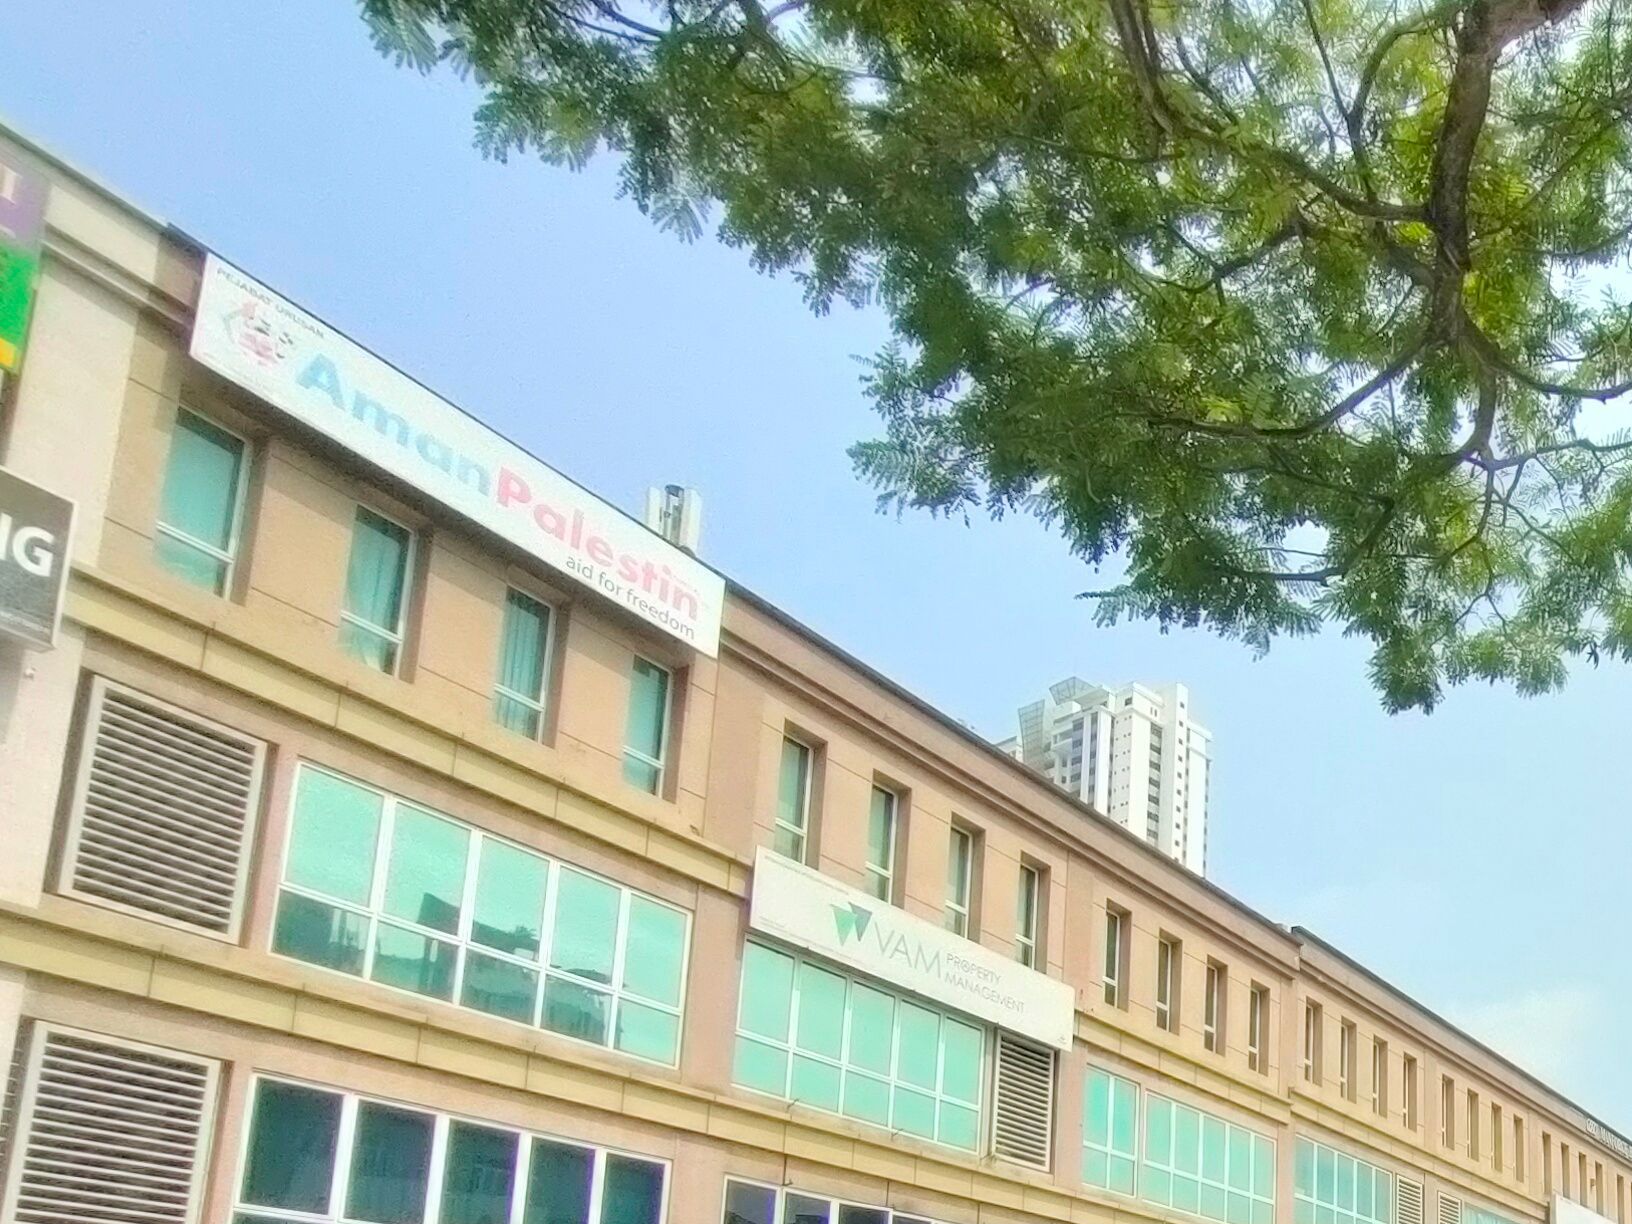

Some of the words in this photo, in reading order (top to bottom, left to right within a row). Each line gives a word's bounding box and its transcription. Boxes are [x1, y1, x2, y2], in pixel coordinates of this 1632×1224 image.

[566, 554, 593, 580] aid
[598, 571, 623, 598] for
[626, 588, 695, 640] freedom
[874, 921, 941, 979] VAM
[946, 953, 1002, 982] PROPERTY
[944, 972, 1025, 1015] MANAGEMENT
